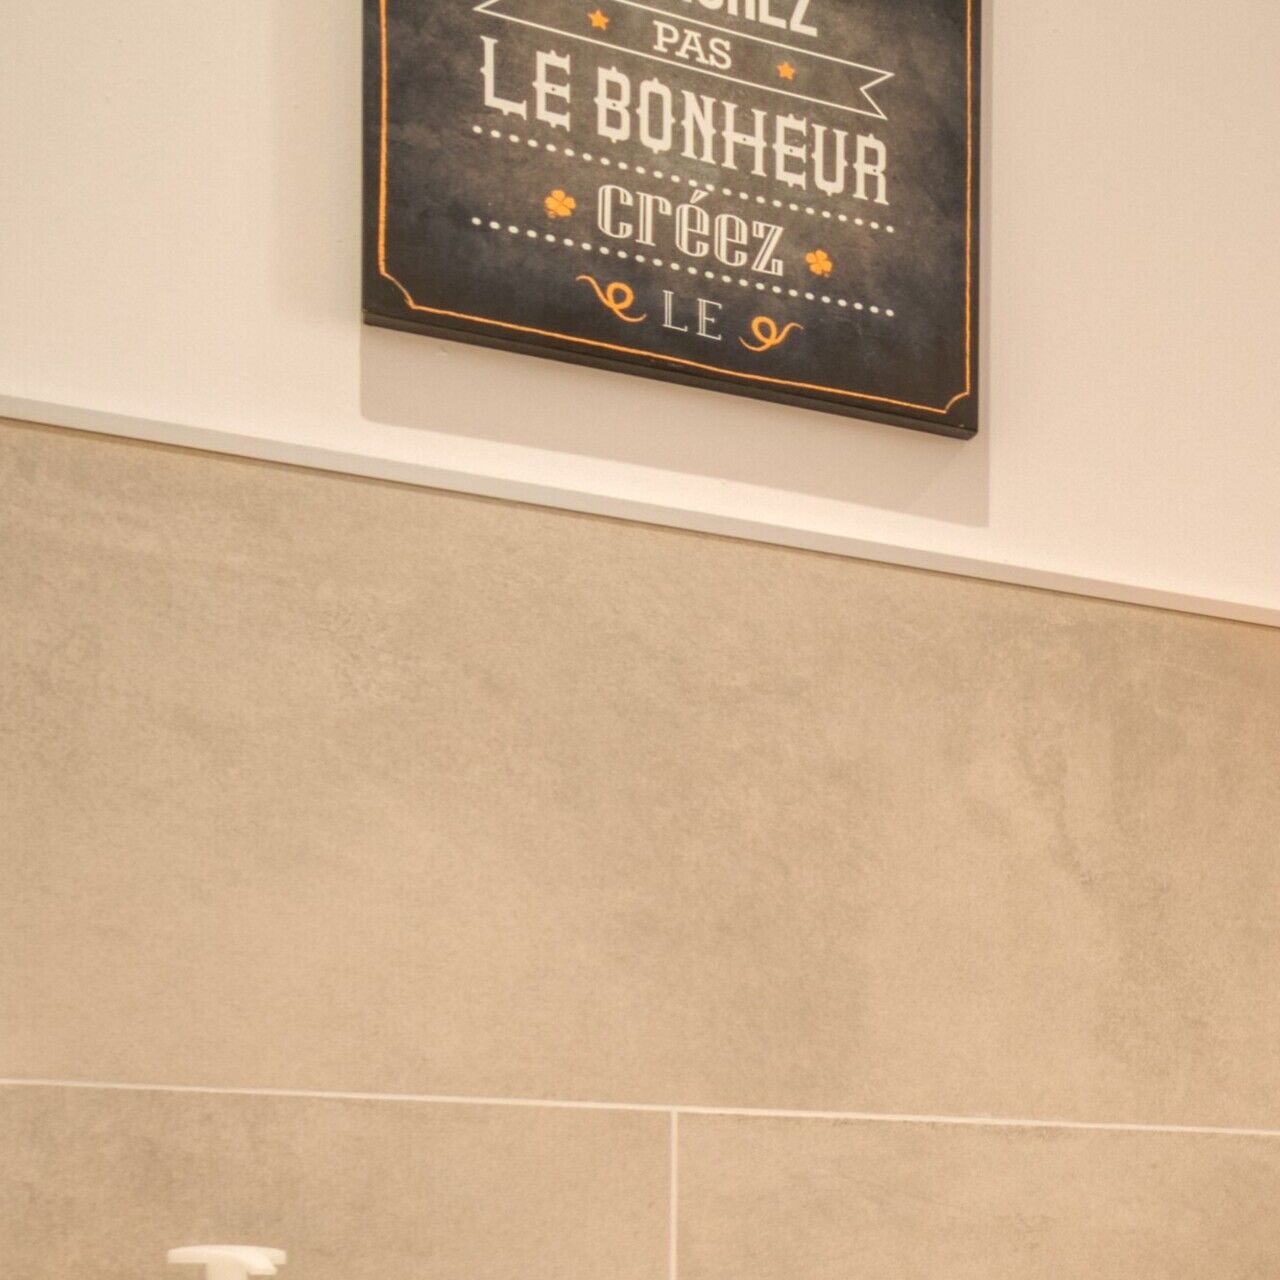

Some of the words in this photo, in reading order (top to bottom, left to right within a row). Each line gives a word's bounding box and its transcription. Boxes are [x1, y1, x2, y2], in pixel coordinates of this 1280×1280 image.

[653, 20, 732, 69] PAS
[480, 35, 571, 131] LE
[594, 65, 889, 206] BONHEUR
[597, 183, 784, 277] créez
[662, 289, 723, 341] LE
